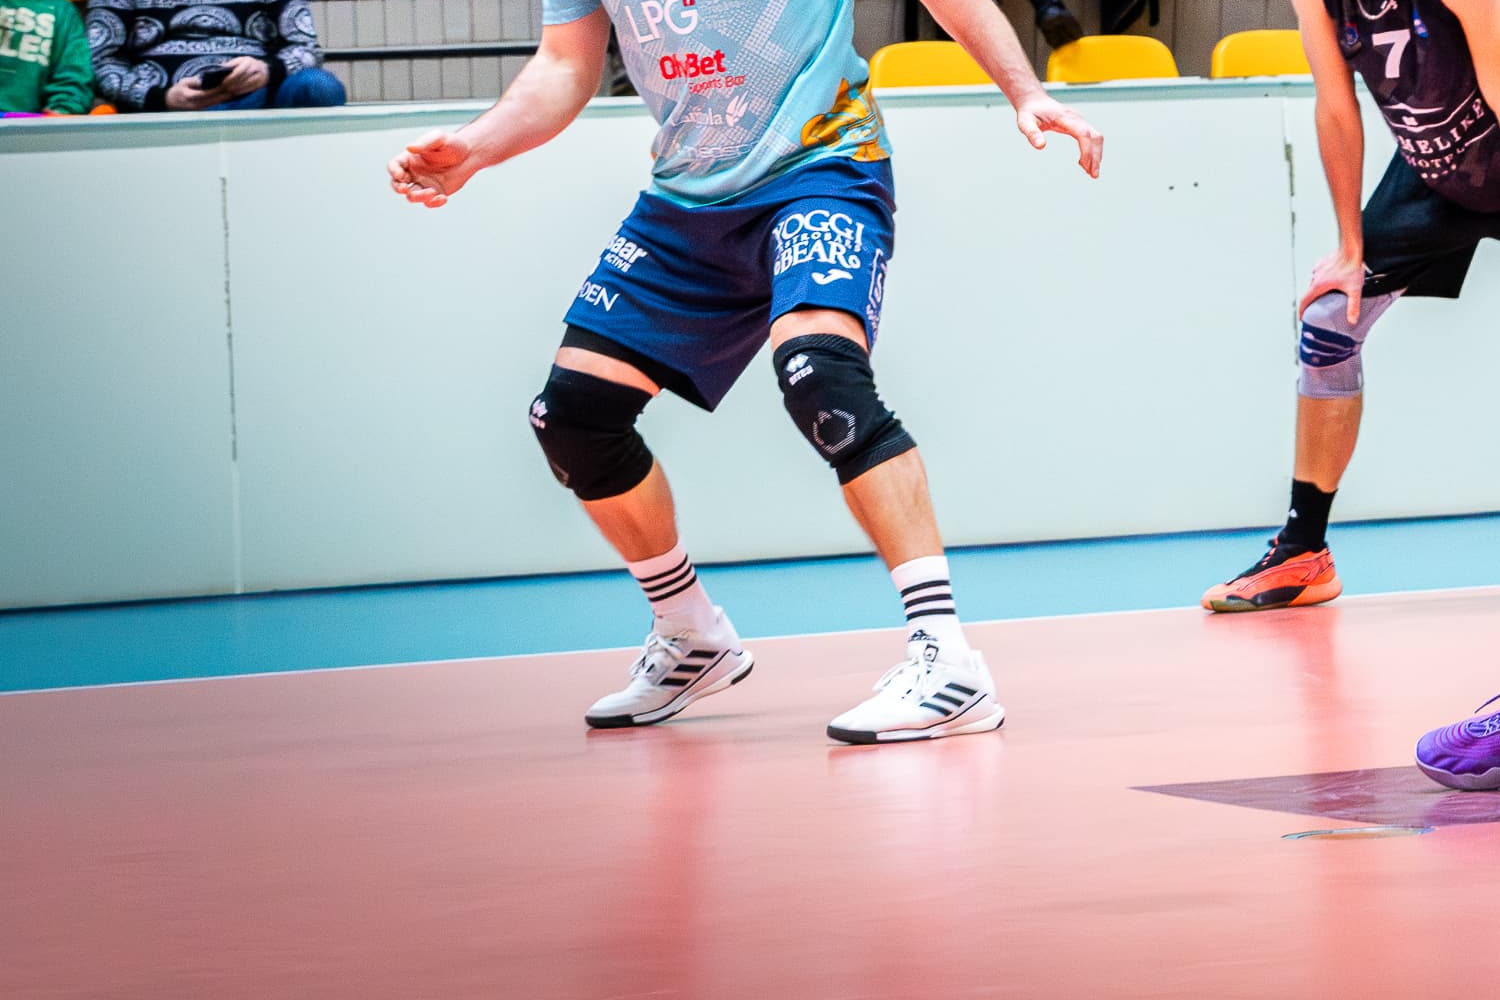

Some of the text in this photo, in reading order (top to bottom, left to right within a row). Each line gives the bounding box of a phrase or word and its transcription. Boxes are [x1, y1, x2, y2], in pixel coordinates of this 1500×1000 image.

[1372, 29, 1411, 79] 7
[771, 209, 865, 251] YOGGI
[778, 239, 859, 274] BEAR
